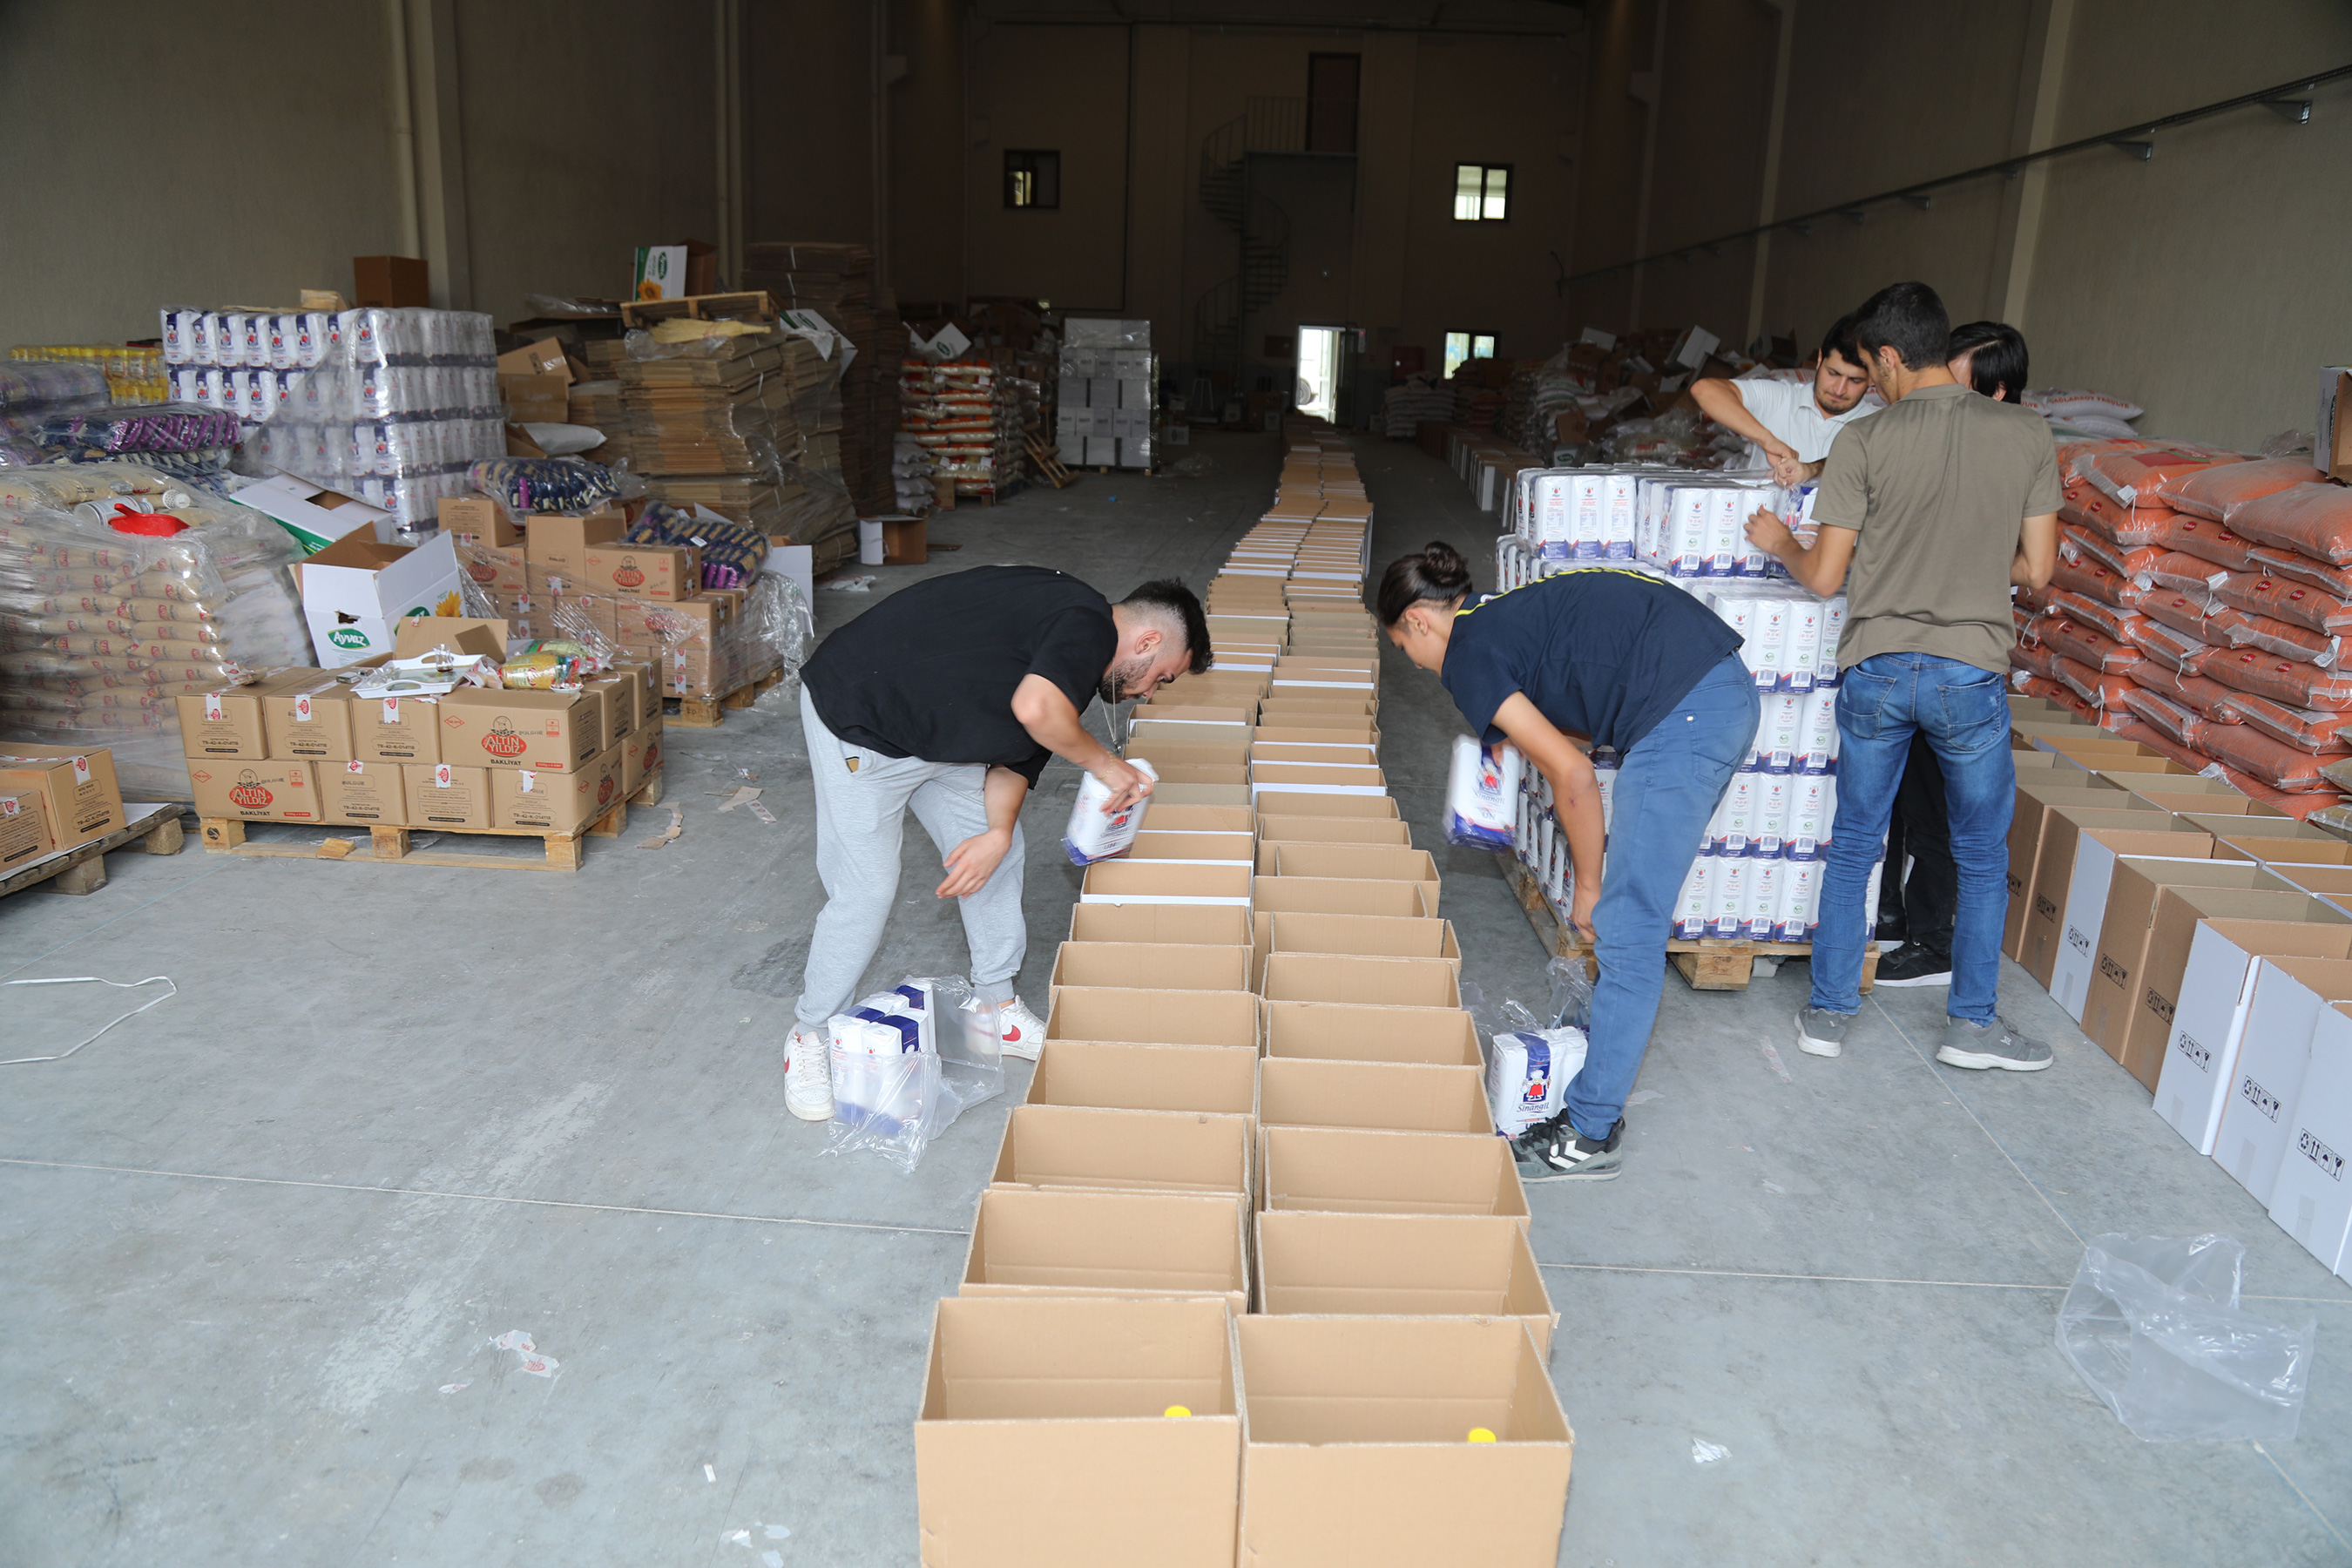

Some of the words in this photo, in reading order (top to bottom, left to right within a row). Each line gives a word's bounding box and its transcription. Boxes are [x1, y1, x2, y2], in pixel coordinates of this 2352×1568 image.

[333, 631, 367, 646] Ayvaz
[484, 735, 520, 748] ALTIN
[488, 744, 521, 754] YILDIZ
[233, 787, 267, 801] ALTIN
[237, 794, 268, 805] YILDIZ
[1474, 790, 1505, 805] Sinangil
[1517, 1101, 1550, 1113] Sinangil
